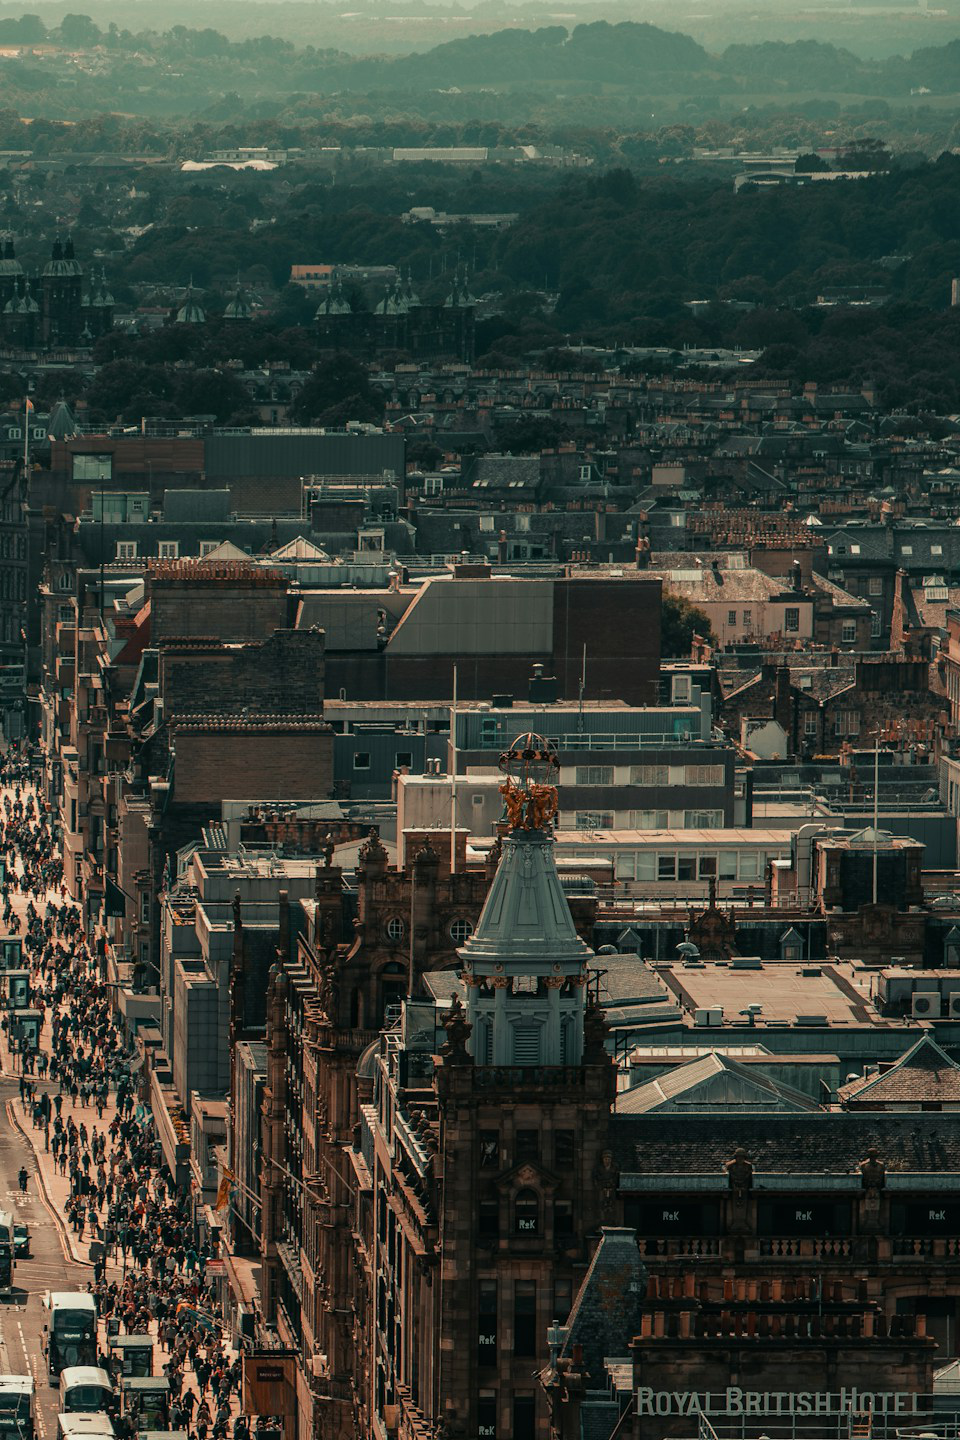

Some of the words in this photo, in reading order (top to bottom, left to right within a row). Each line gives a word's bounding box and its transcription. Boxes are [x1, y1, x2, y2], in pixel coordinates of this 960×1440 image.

[637, 1387, 720, 1417] ROYAL
[725, 1386, 832, 1417] BRITISH
[839, 1386, 928, 1417] HOTEL
